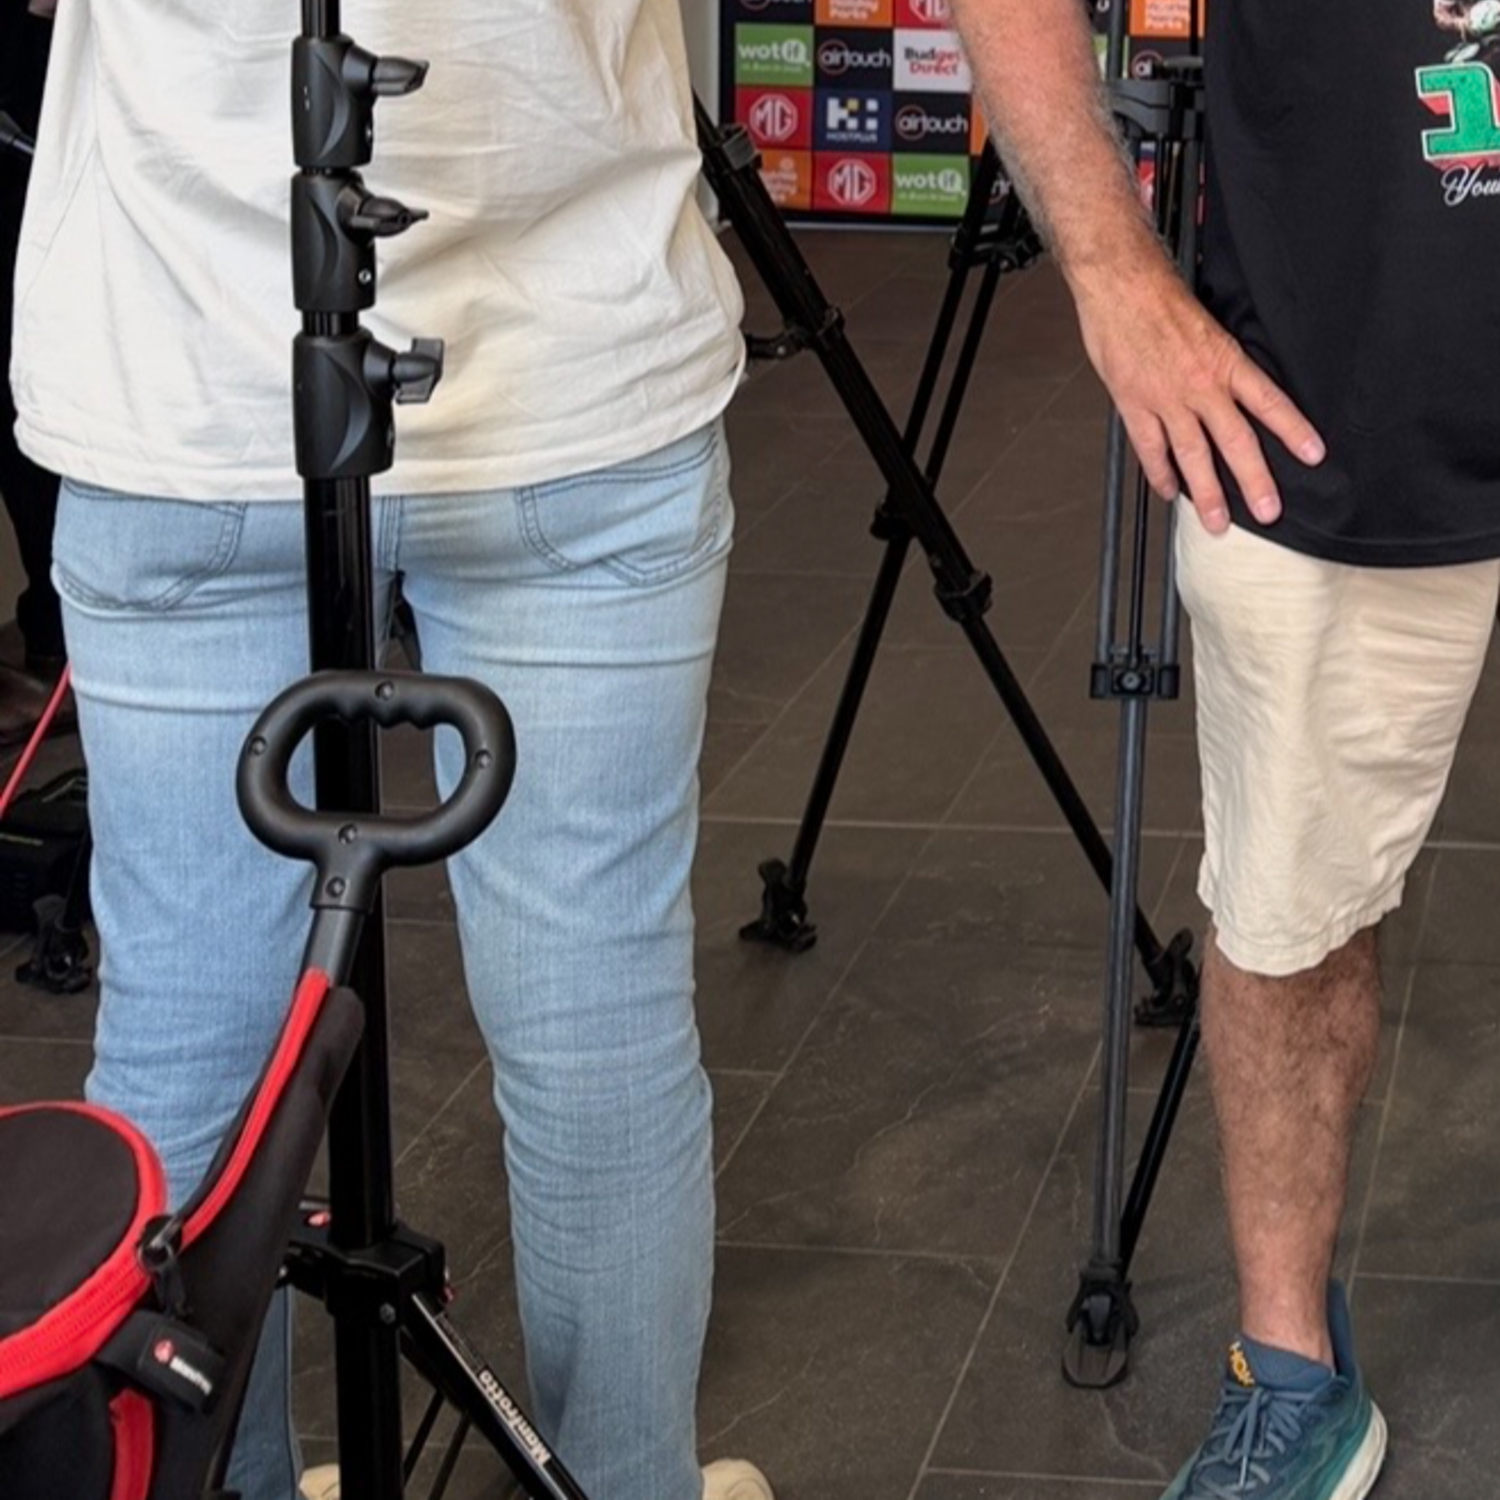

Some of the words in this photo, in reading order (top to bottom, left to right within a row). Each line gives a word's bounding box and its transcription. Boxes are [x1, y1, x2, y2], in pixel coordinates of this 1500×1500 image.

[821, 47, 891, 67] airtouch
[904, 47, 960, 63] Budget
[909, 61, 957, 75] Direct
[754, 97, 794, 138] MG
[900, 113, 968, 133] airtouch
[826, 131, 877, 143] HOSTPLUS
[832, 162, 872, 202] MG
[479, 1369, 551, 1466] Manfrotto
